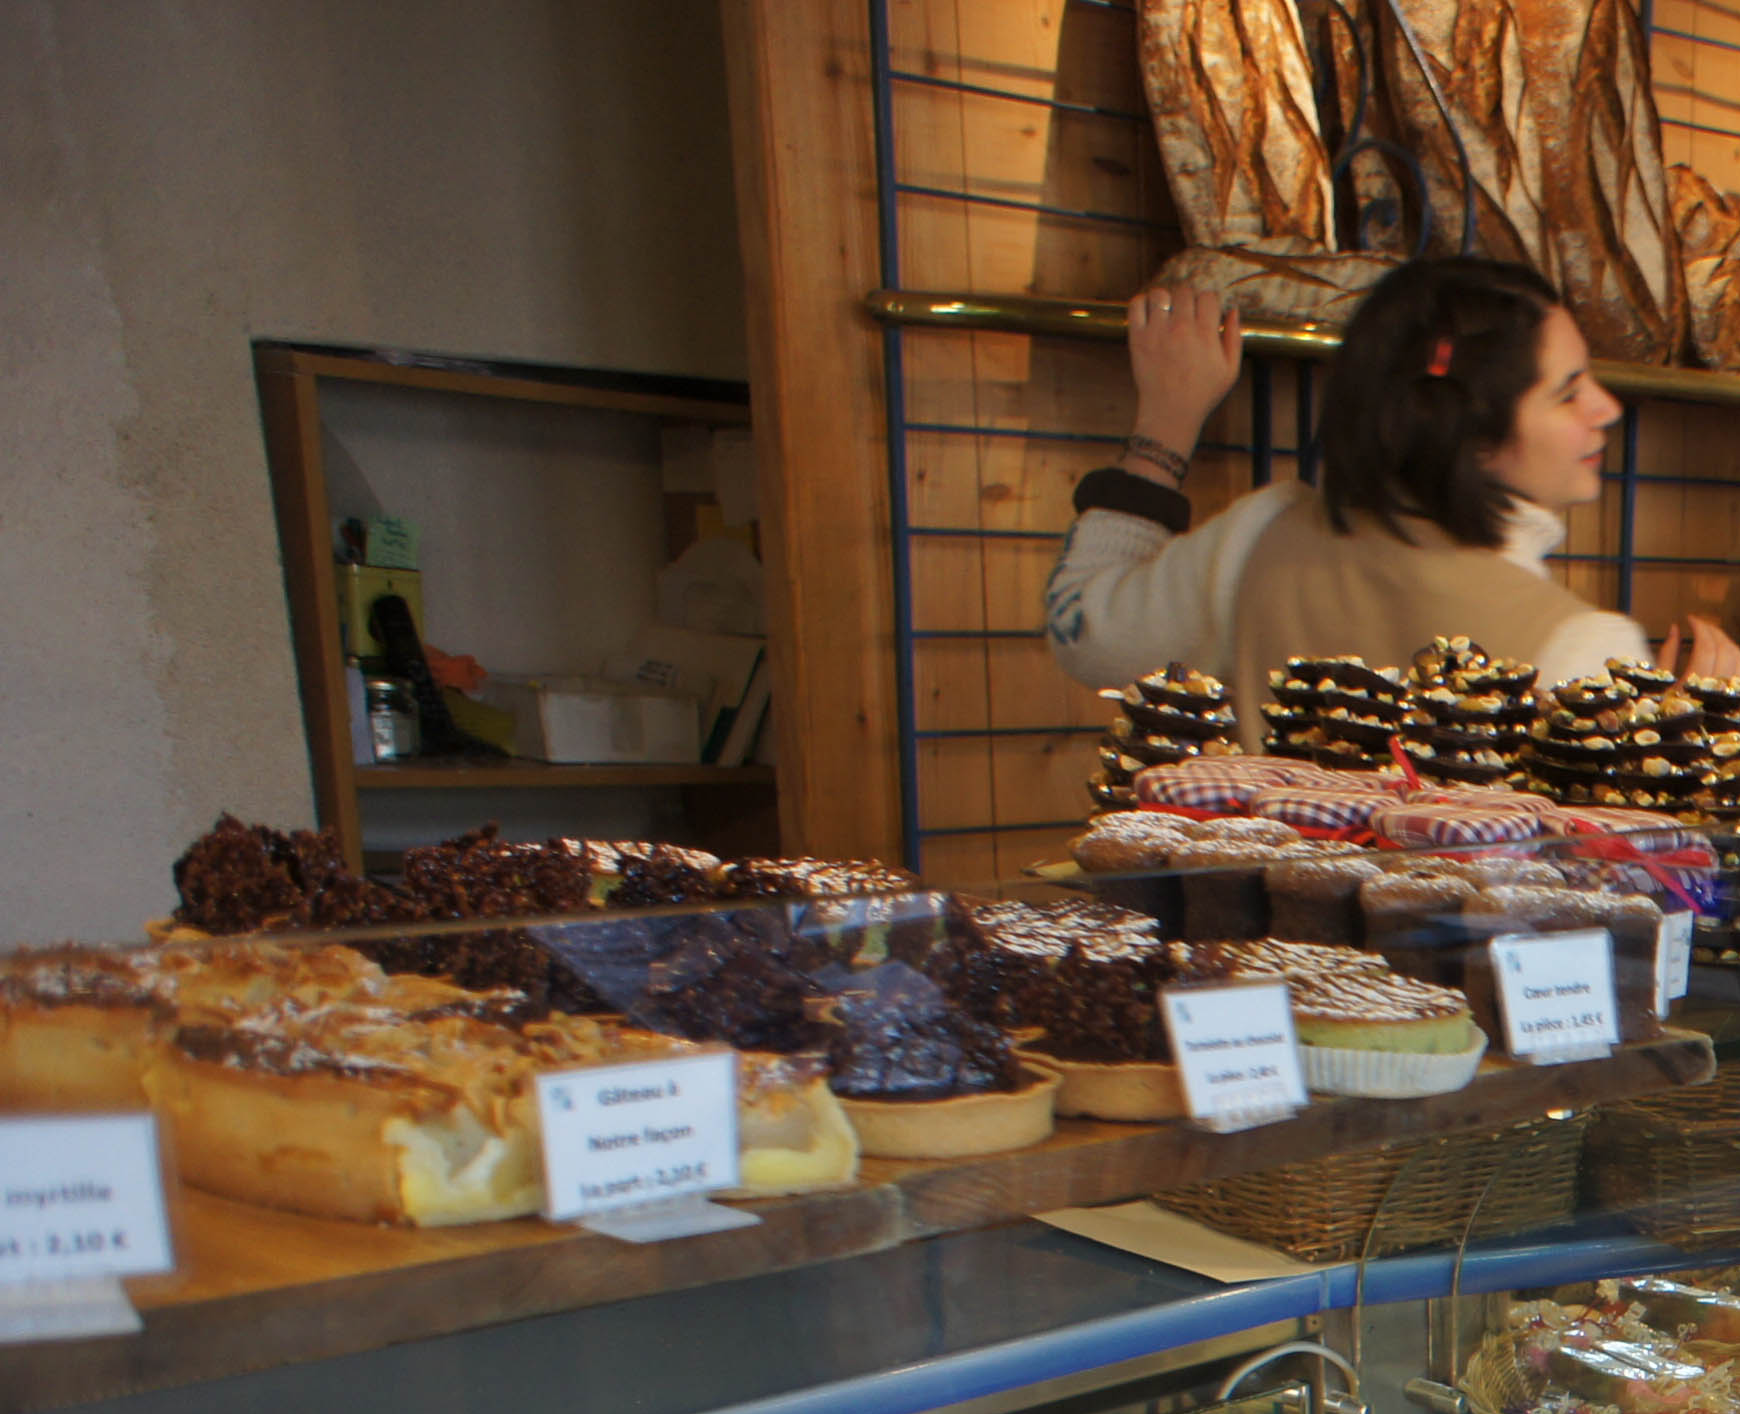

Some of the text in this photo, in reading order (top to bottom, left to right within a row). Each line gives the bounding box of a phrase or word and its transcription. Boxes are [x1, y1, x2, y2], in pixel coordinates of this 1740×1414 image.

[1555, 981, 1591, 998] tendre
[597, 1082, 663, 1107] Gâteau
[587, 1123, 693, 1152] Notre façon
[6, 1181, 114, 1210] myrtille
